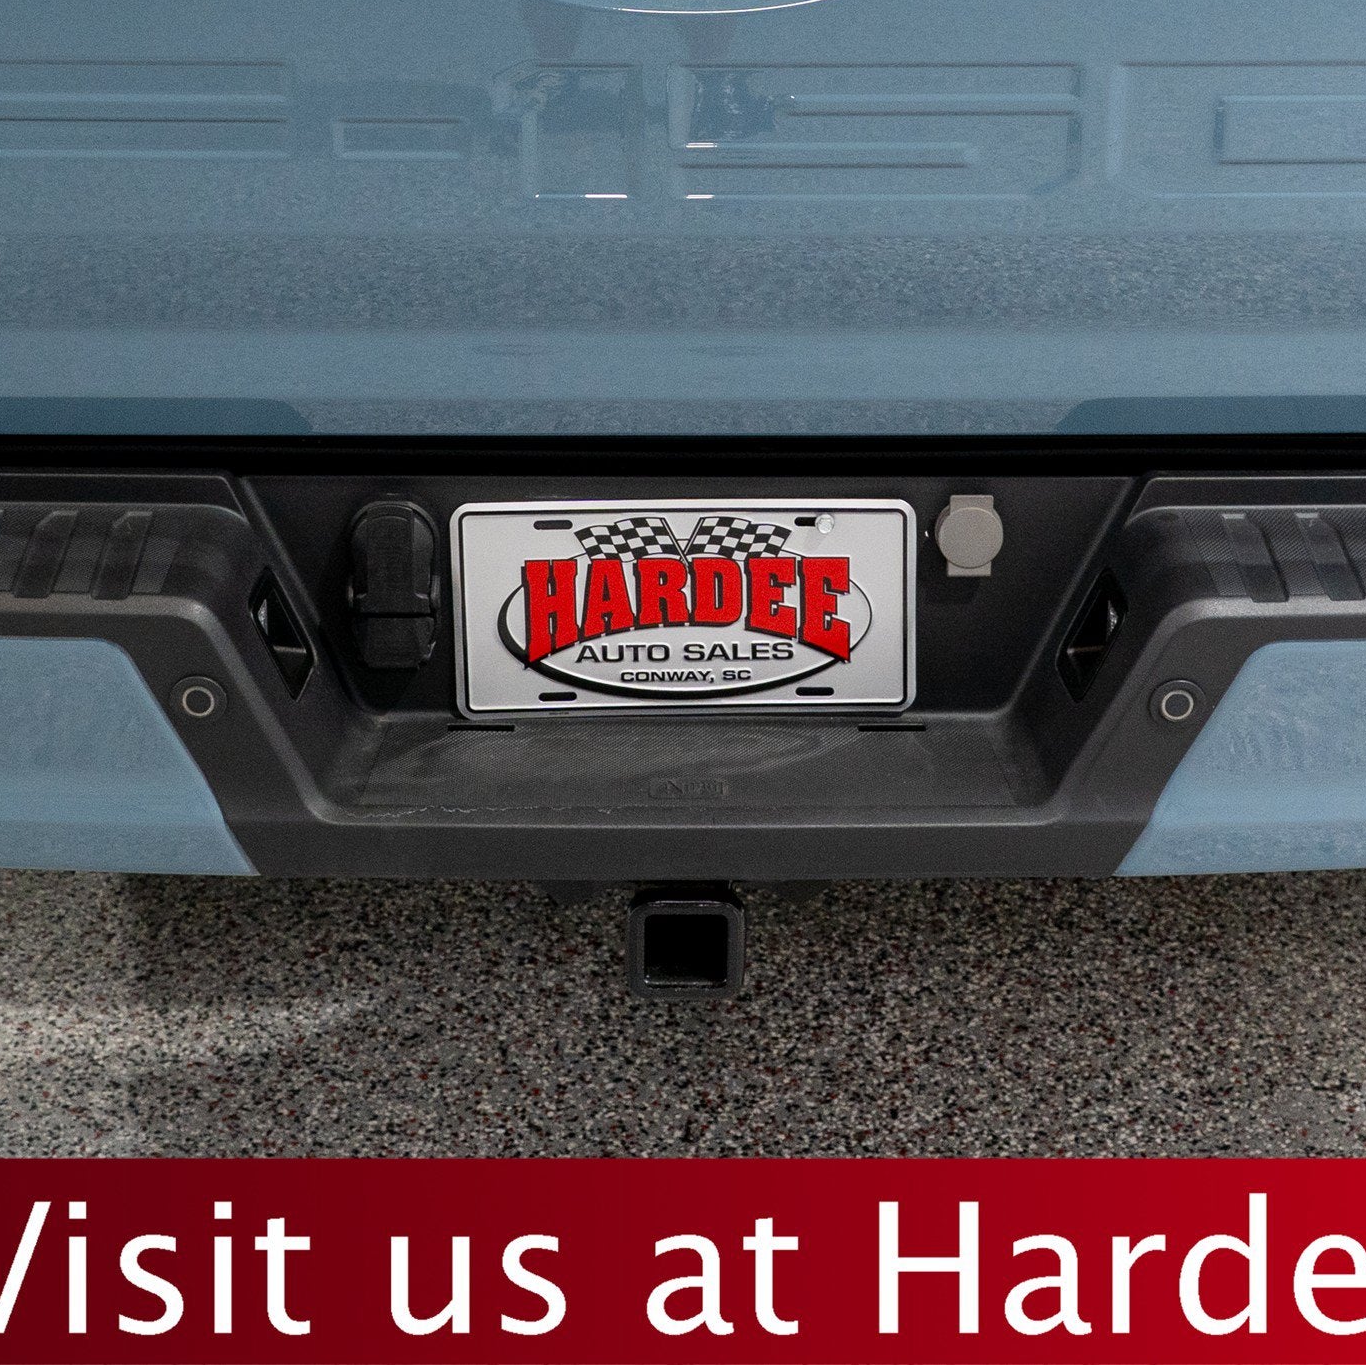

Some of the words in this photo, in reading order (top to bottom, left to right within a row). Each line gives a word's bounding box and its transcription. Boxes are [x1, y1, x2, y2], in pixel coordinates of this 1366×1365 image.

[521, 556, 851, 669] HARDEE
[574, 642, 671, 664] AUTO
[682, 640, 795, 662] SALES
[619, 668, 716, 684] CONWAY,
[721, 668, 753, 682] SC
